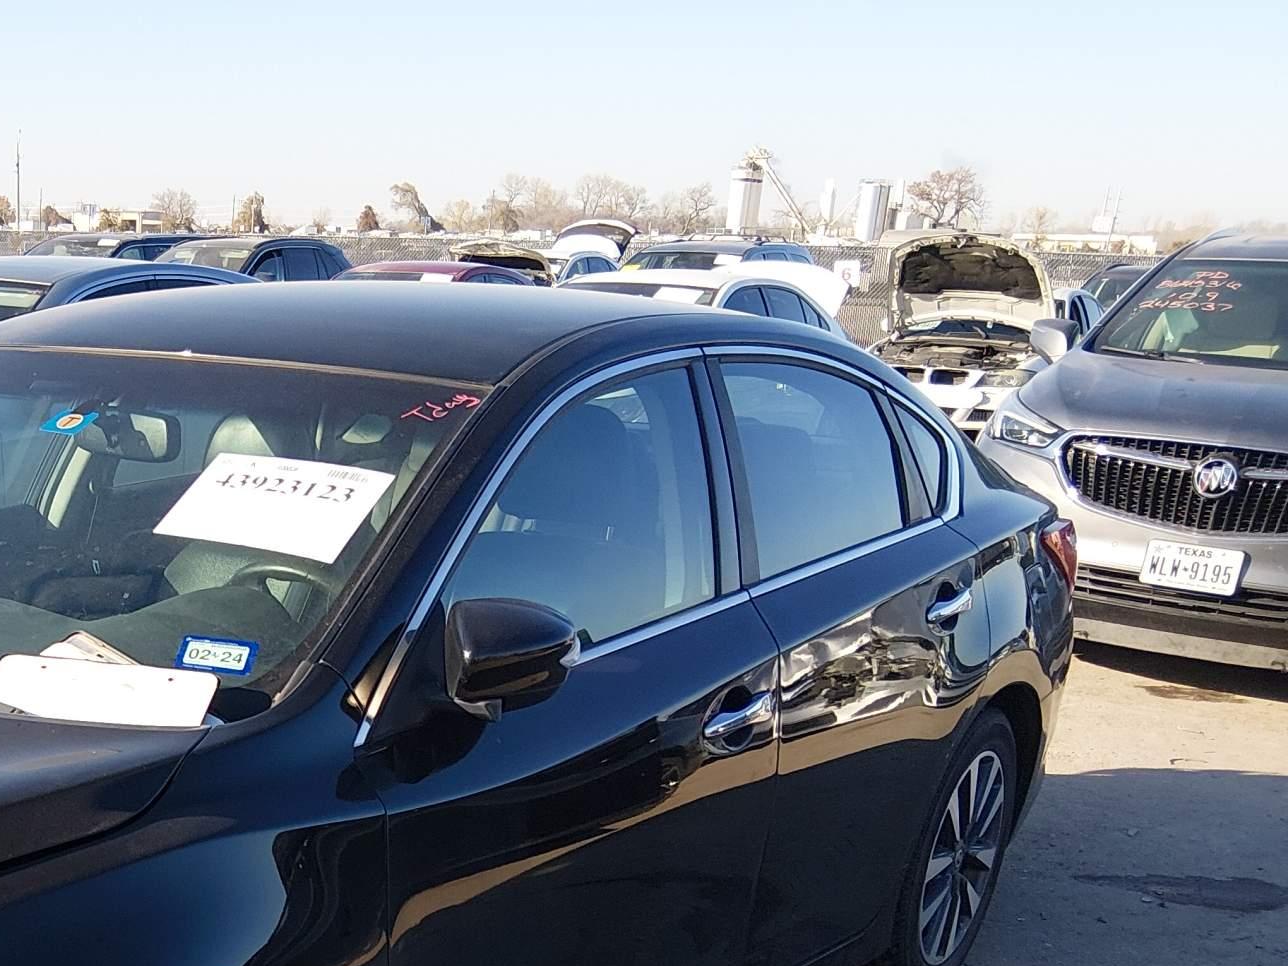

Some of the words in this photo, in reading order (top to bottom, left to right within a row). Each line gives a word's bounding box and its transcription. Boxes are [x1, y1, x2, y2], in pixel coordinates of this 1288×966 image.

[842, 267, 851, 281] 6
[215, 473, 355, 502] 43923123
[1178, 547, 1213, 559] TEXAS
